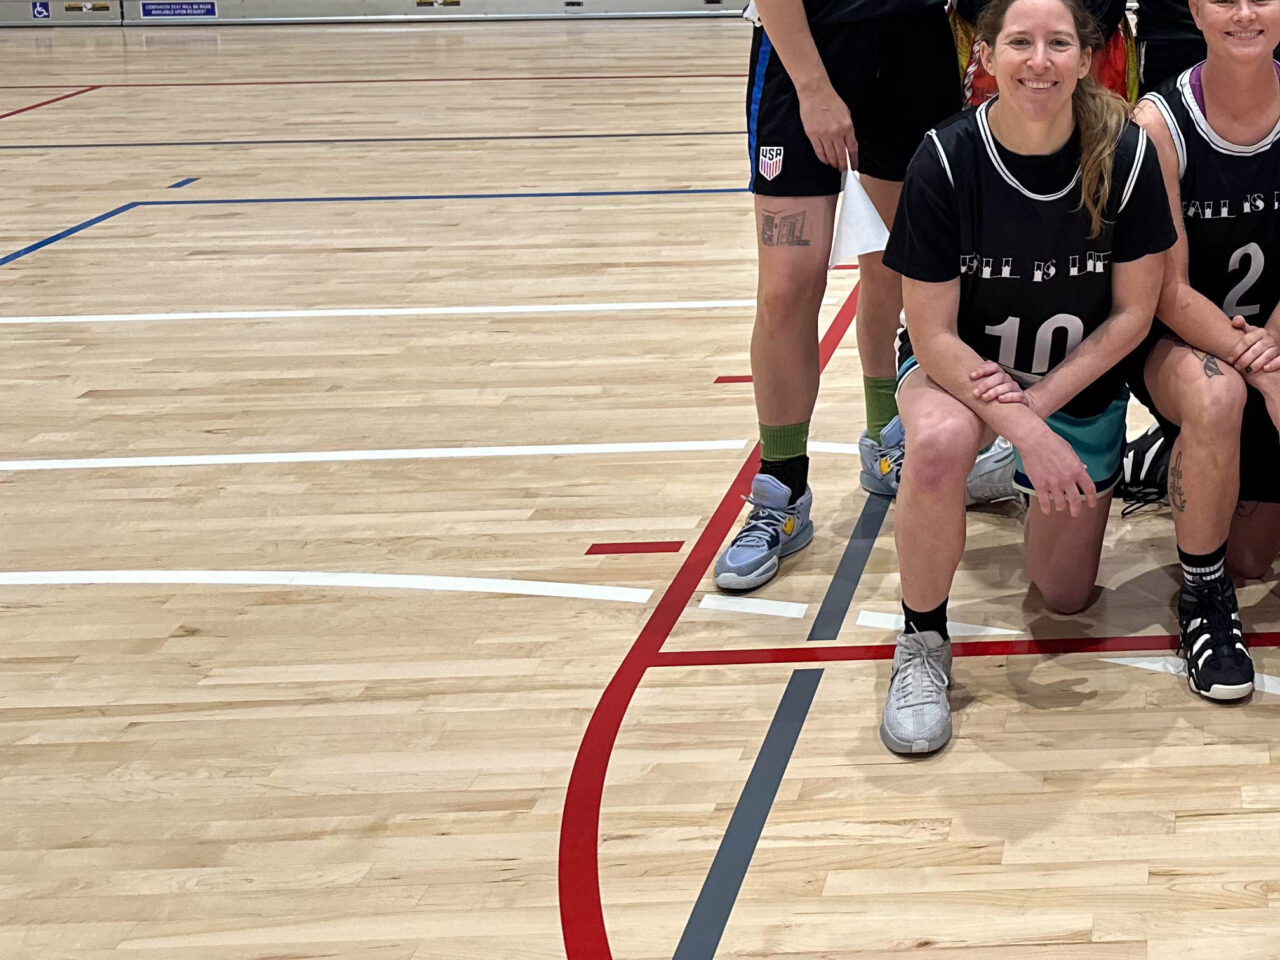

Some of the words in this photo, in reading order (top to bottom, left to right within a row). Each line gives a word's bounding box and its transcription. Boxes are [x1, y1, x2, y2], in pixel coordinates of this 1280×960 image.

[761, 147, 782, 161] USA
[1243, 193, 1265, 213] IS
[1032, 259, 1057, 282] IS
[1222, 242, 1265, 318] 2
[984, 313, 1084, 374] 10
